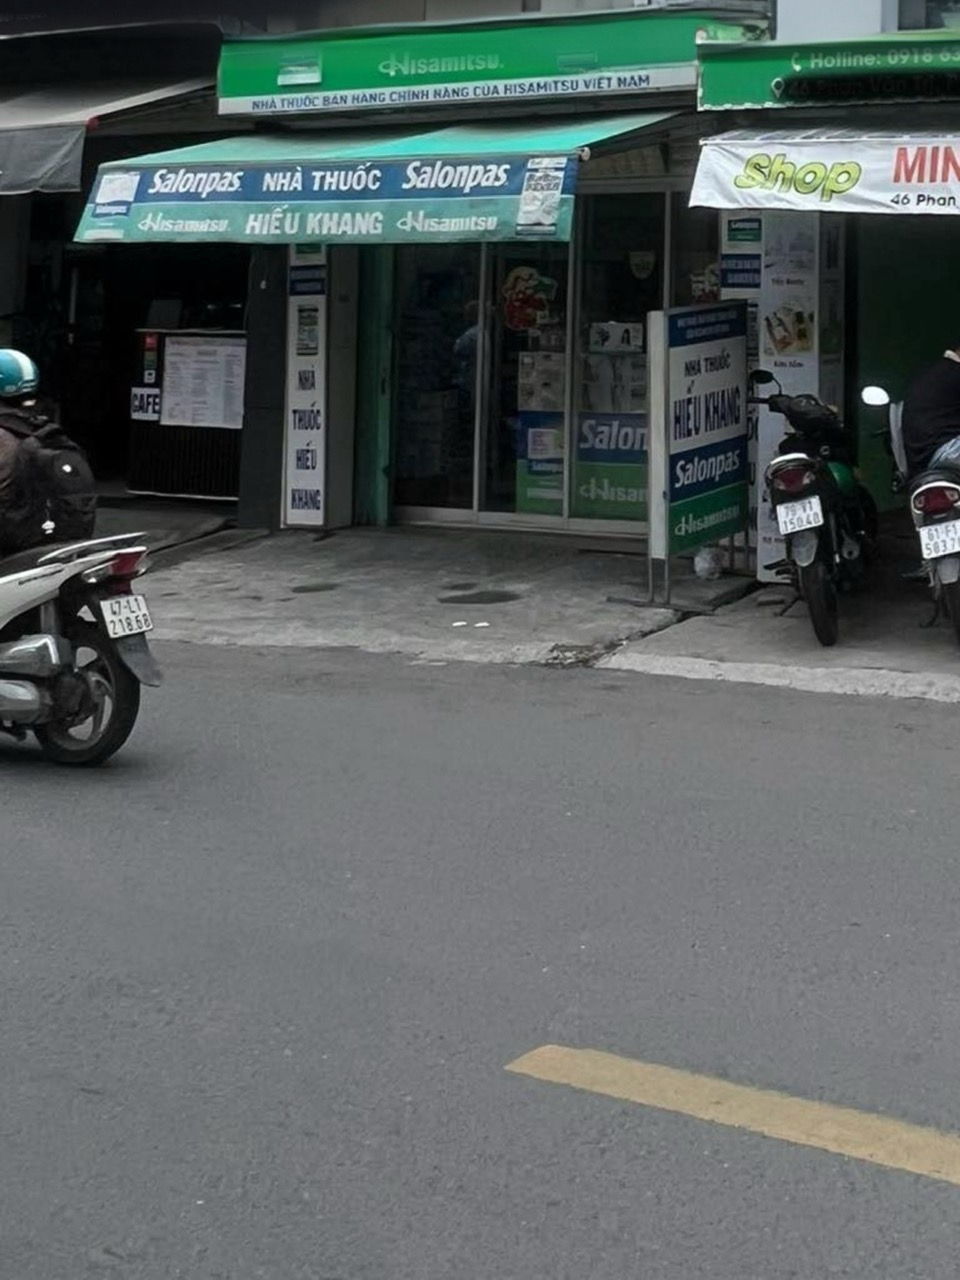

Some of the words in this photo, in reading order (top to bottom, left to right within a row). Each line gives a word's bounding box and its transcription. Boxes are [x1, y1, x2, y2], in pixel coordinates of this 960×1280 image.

[810, 51, 882, 69] Hotline:
[887, 48, 934, 65] 0918
[252, 95, 278, 111] NHÀ
[503, 79, 579, 95] HISAMITSU
[617, 73, 651, 88] NAM
[148, 168, 243, 198] Salonpas
[262, 166, 302, 191] NHÀ
[312, 162, 382, 191] THUỐC
[401, 160, 511, 193] Salonpas
[734, 153, 862, 202] Shop
[890, 193, 911, 206] 46
[916, 193, 957, 206] Phan
[245, 204, 300, 235] HIẾU
[306, 211, 383, 235] KHANG
[705, 384, 742, 435] KHANG
[674, 449, 741, 490] Salonpas
